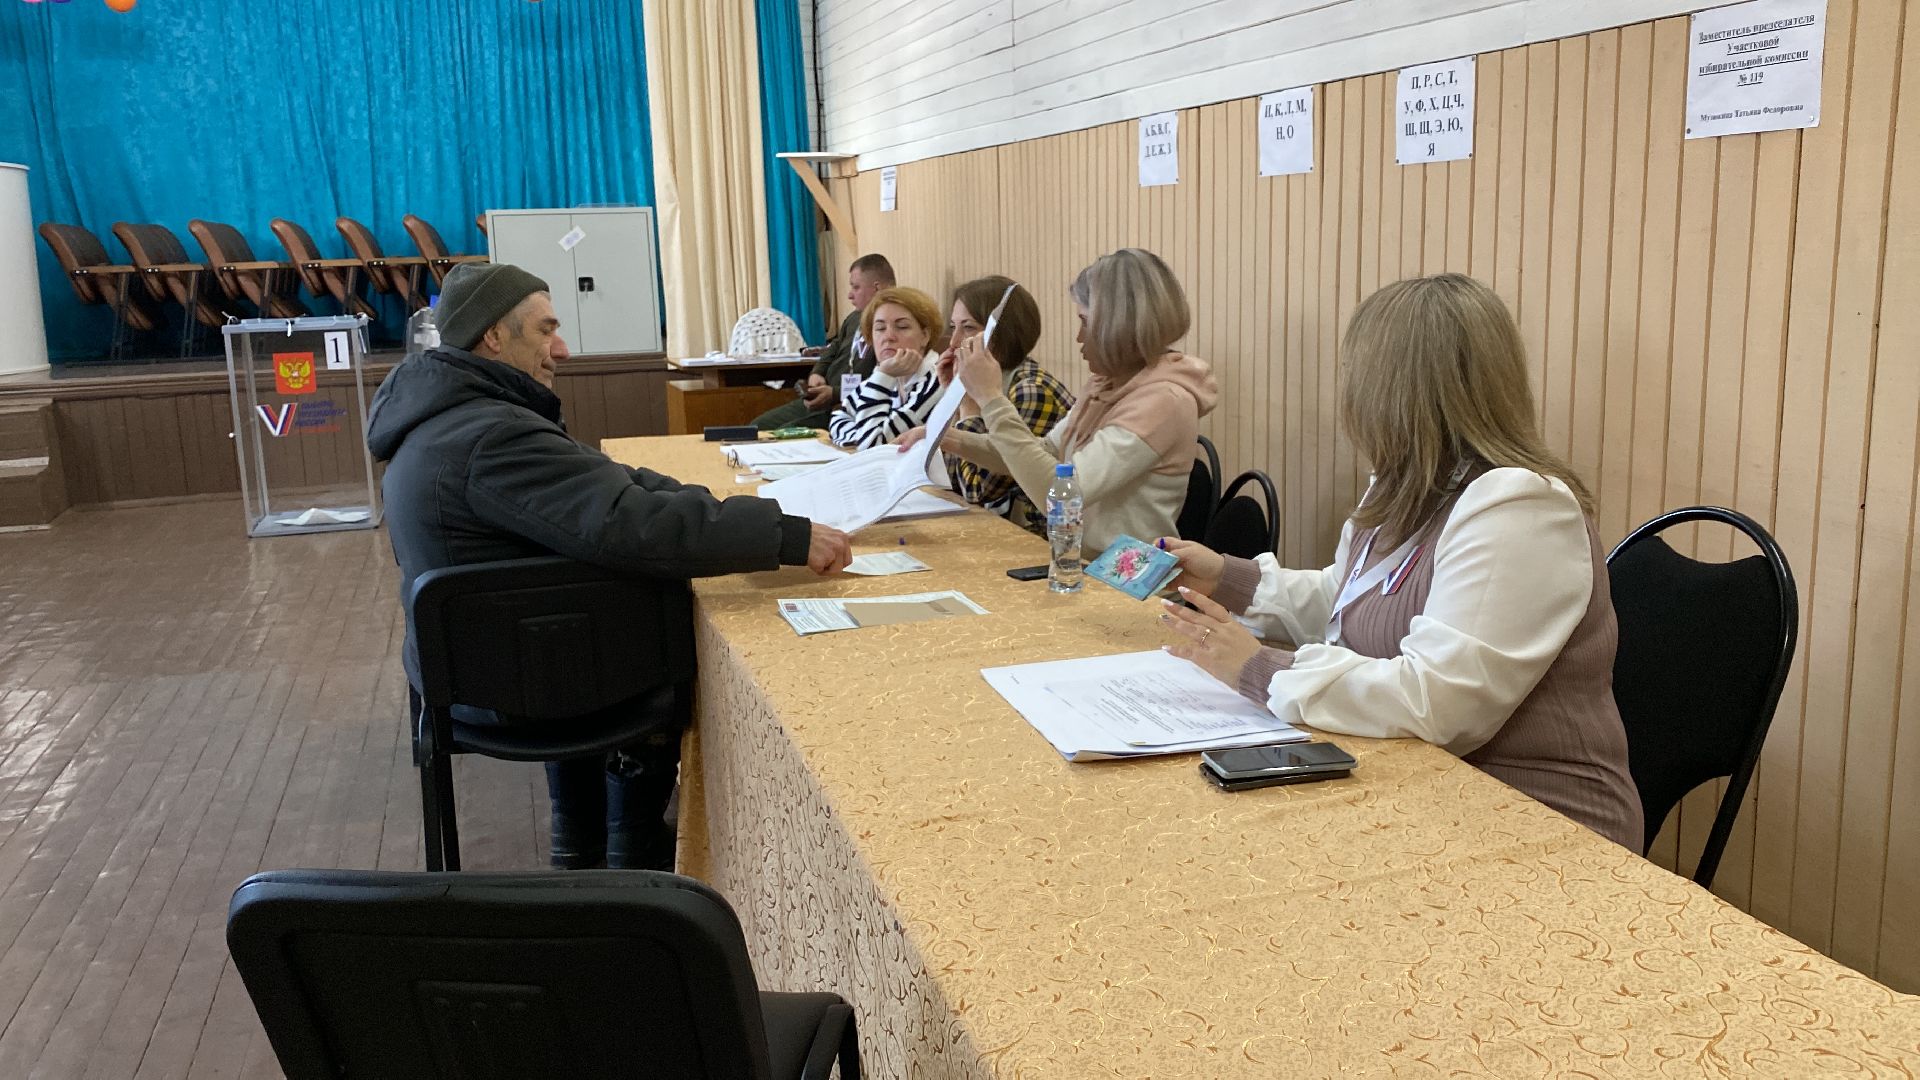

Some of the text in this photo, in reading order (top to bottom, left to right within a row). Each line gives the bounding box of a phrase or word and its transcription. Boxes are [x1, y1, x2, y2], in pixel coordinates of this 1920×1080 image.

[1699, 14, 1815, 42] Заместитель председателя
[1727, 36, 1780, 53] Участковой
[1699, 50, 1809, 74] избирательной комиссии
[1750, 71, 1764, 82] 119
[1427, 142, 1435, 156] Я
[330, 337, 343, 363] 1
